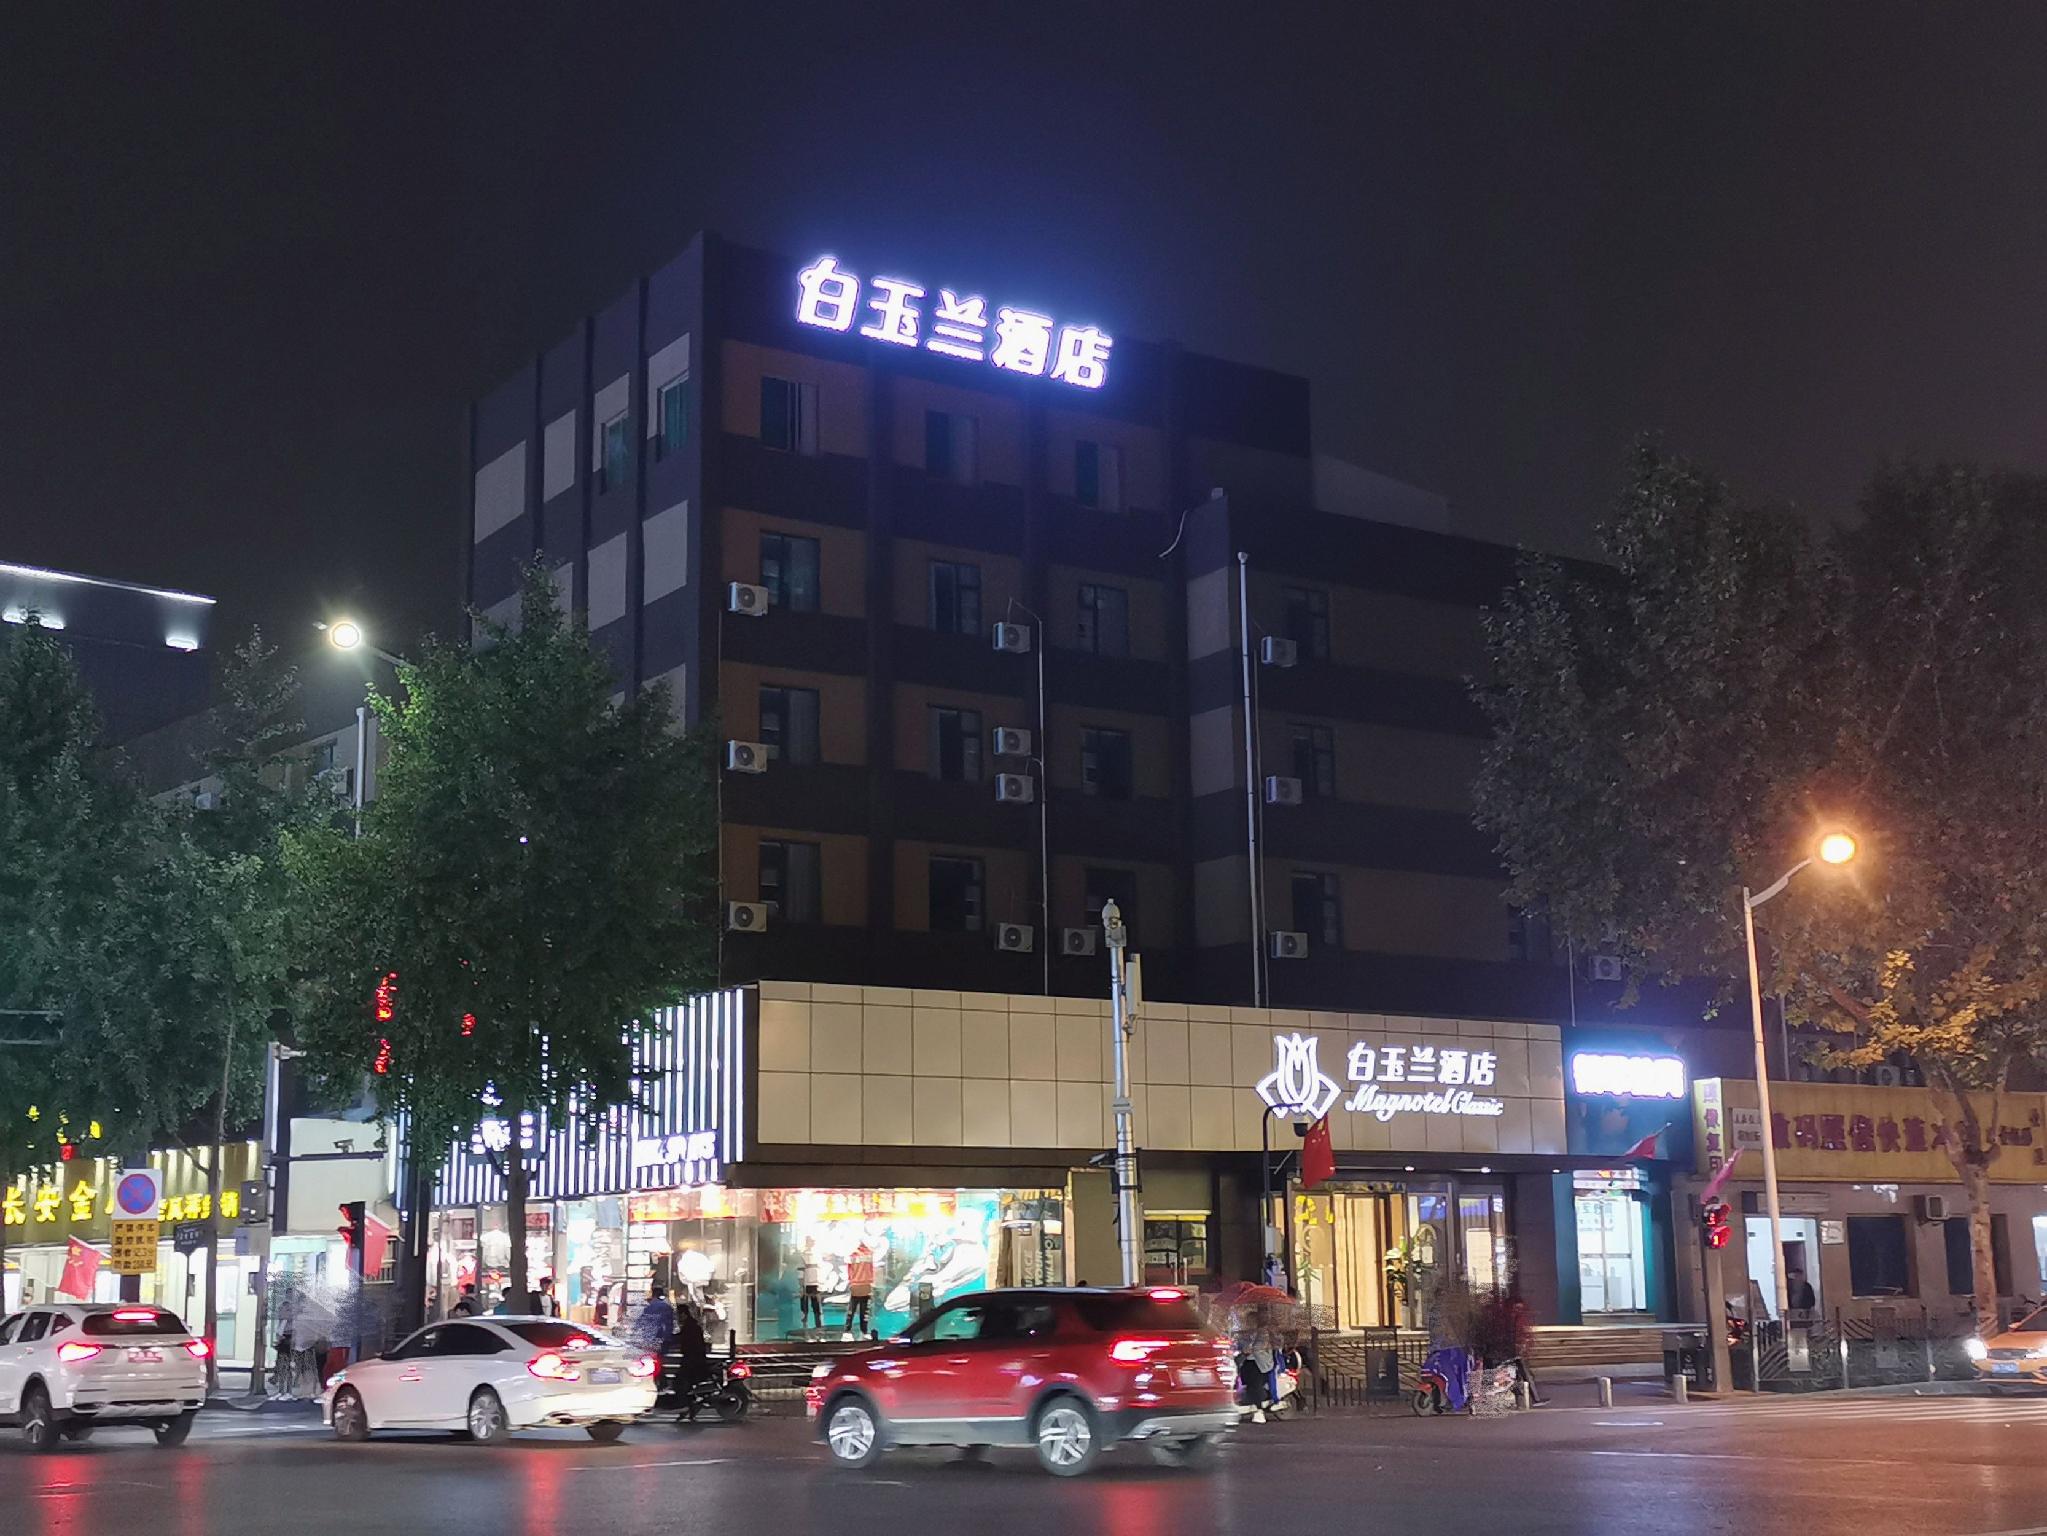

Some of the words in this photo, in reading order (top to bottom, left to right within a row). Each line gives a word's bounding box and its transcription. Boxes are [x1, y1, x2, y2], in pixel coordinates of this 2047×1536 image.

[797, 257, 1114, 389] 白玉兰酒店
[1347, 1042, 1497, 1086] 白玉兰酒店
[1345, 1083, 1456, 1121] Magnotel
[2, 1180, 114, 1225] 长安金
